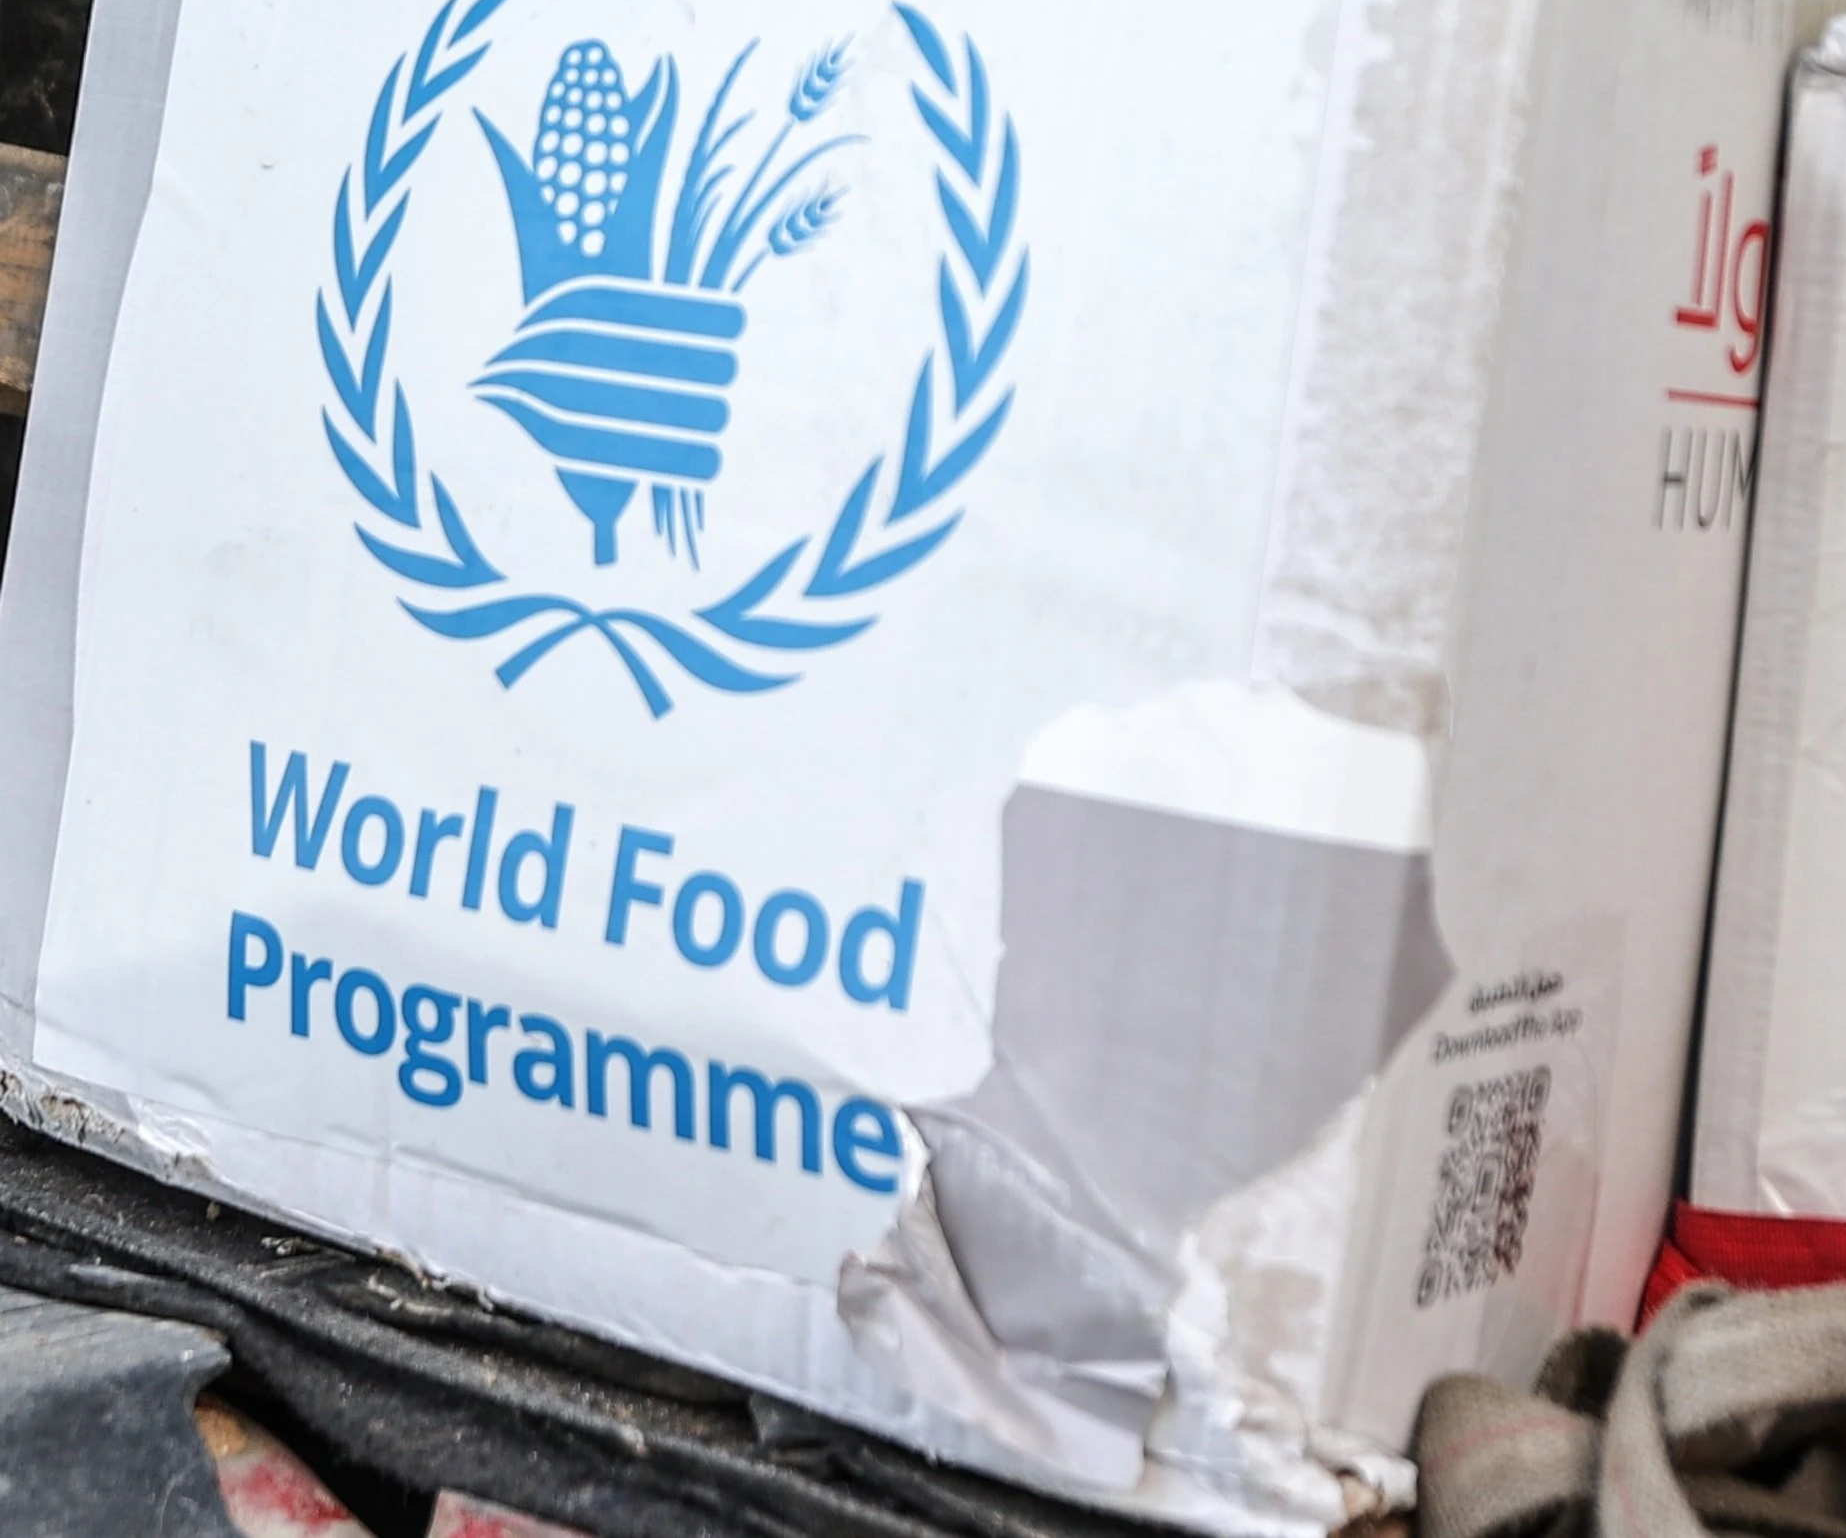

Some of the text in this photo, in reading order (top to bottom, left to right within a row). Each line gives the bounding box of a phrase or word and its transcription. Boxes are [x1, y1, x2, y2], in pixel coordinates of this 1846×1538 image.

[249, 740, 926, 1011] World Food
[227, 910, 905, 1195] Programme
